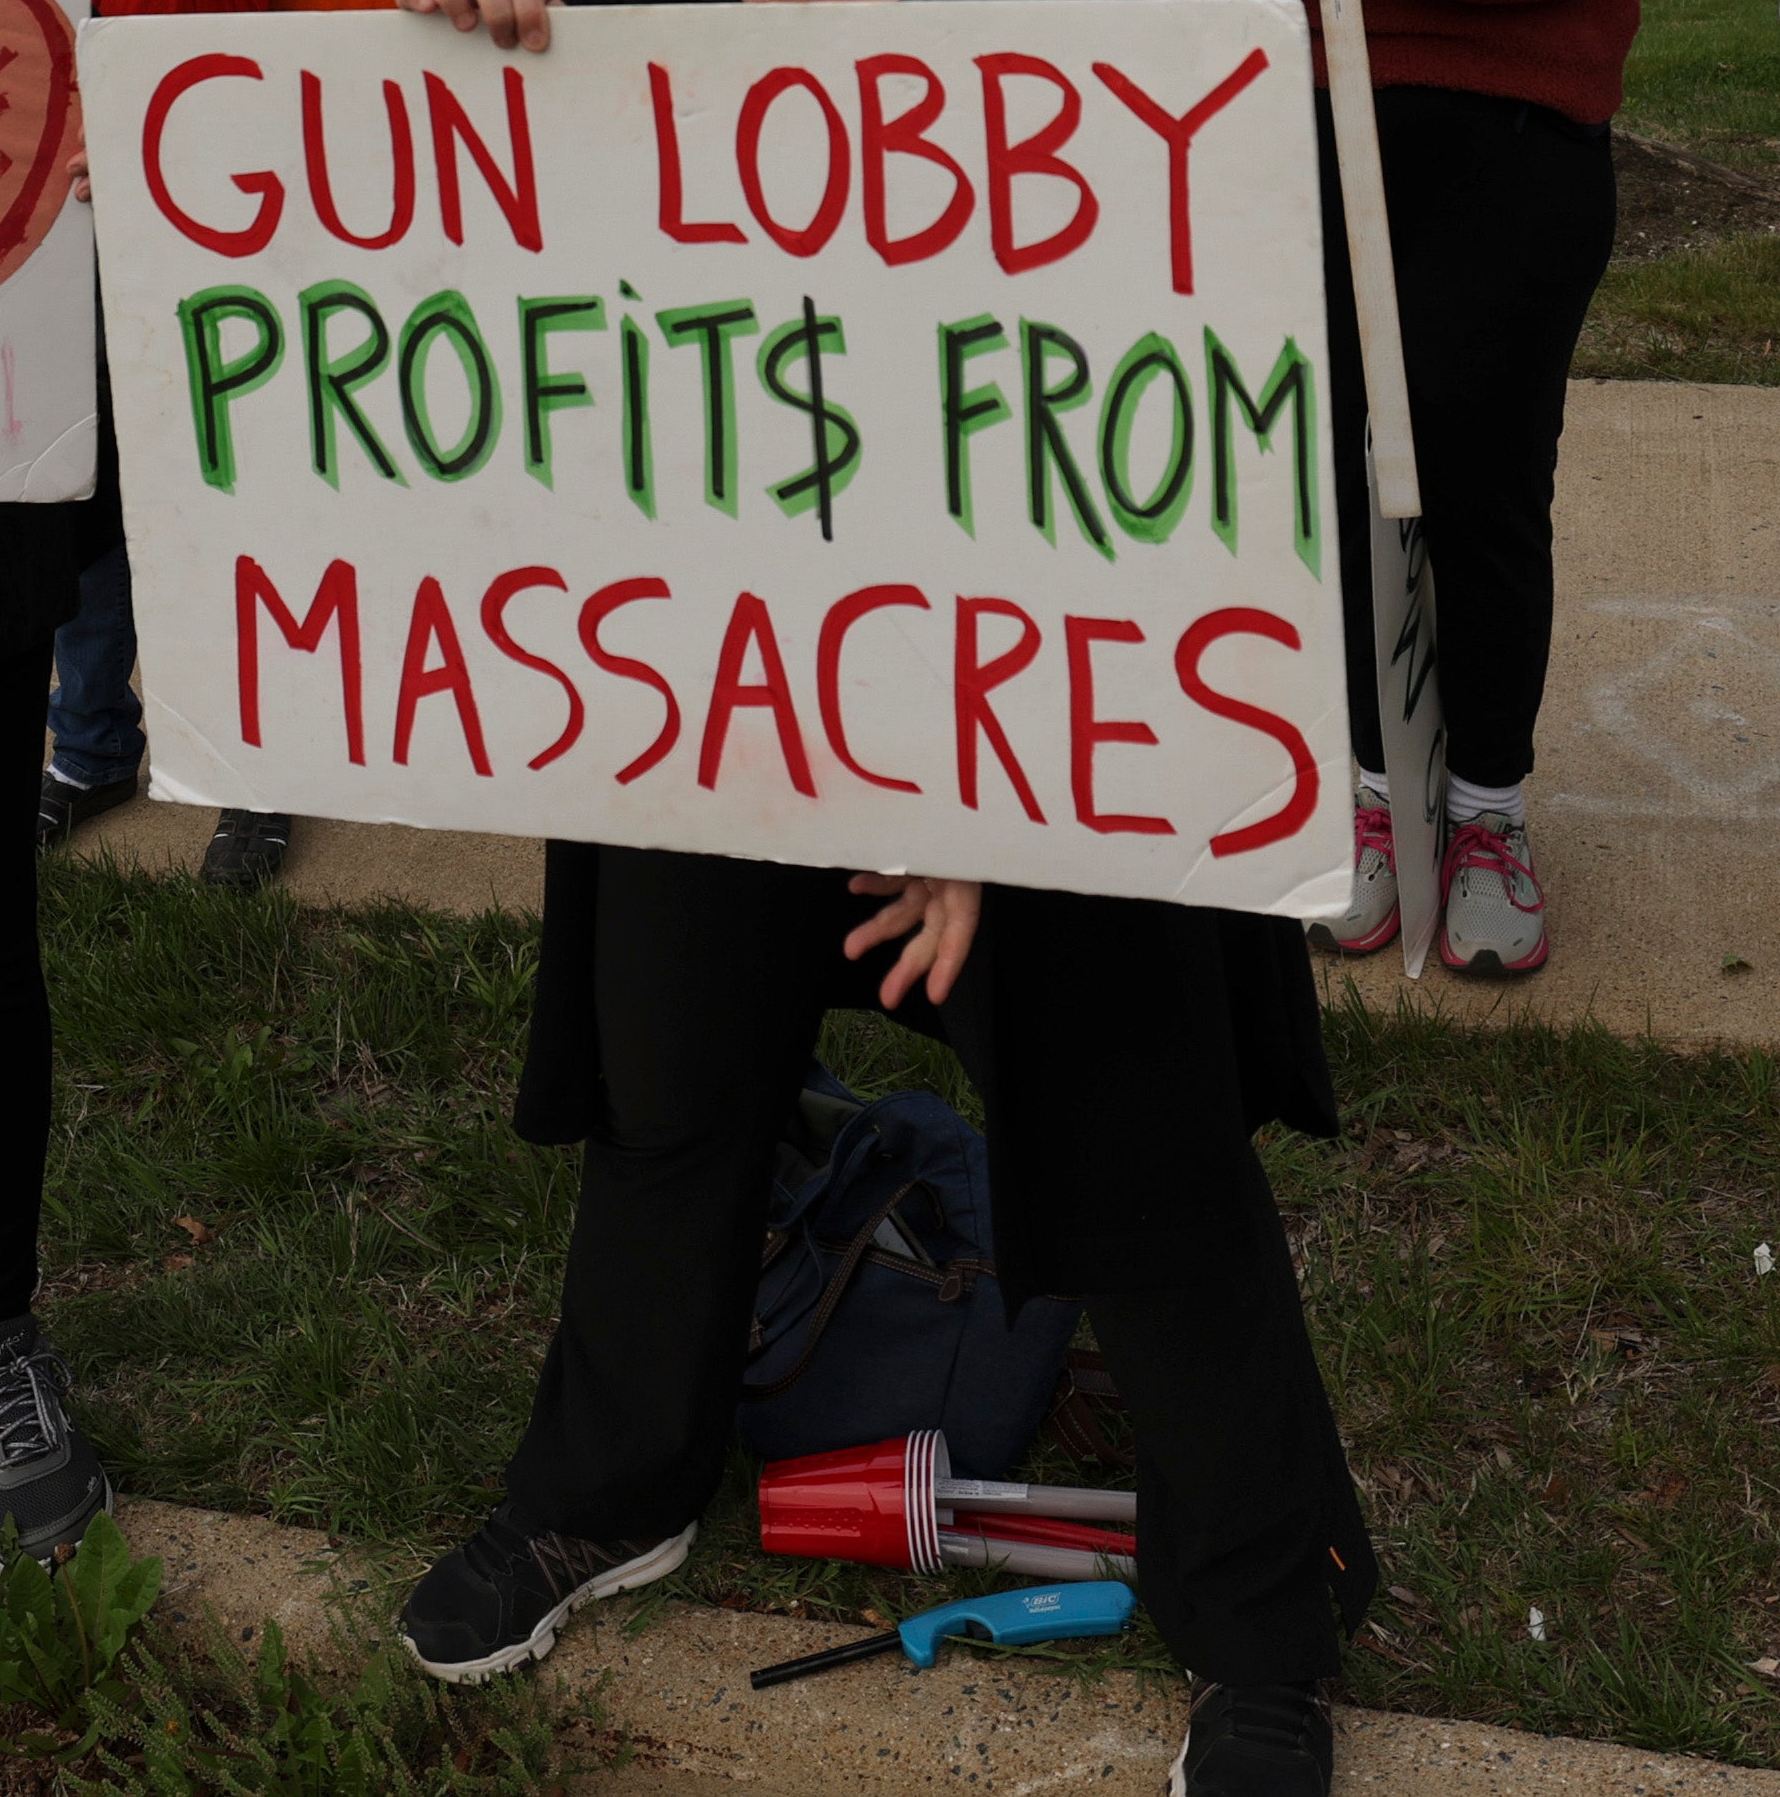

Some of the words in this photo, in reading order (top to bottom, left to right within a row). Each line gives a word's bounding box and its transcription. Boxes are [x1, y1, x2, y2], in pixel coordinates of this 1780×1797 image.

[142, 52, 543, 258] GUN
[647, 48, 1269, 296] LOBBY
[937, 313, 1321, 581] FROM
[235, 554, 1320, 858] MASSACRES
